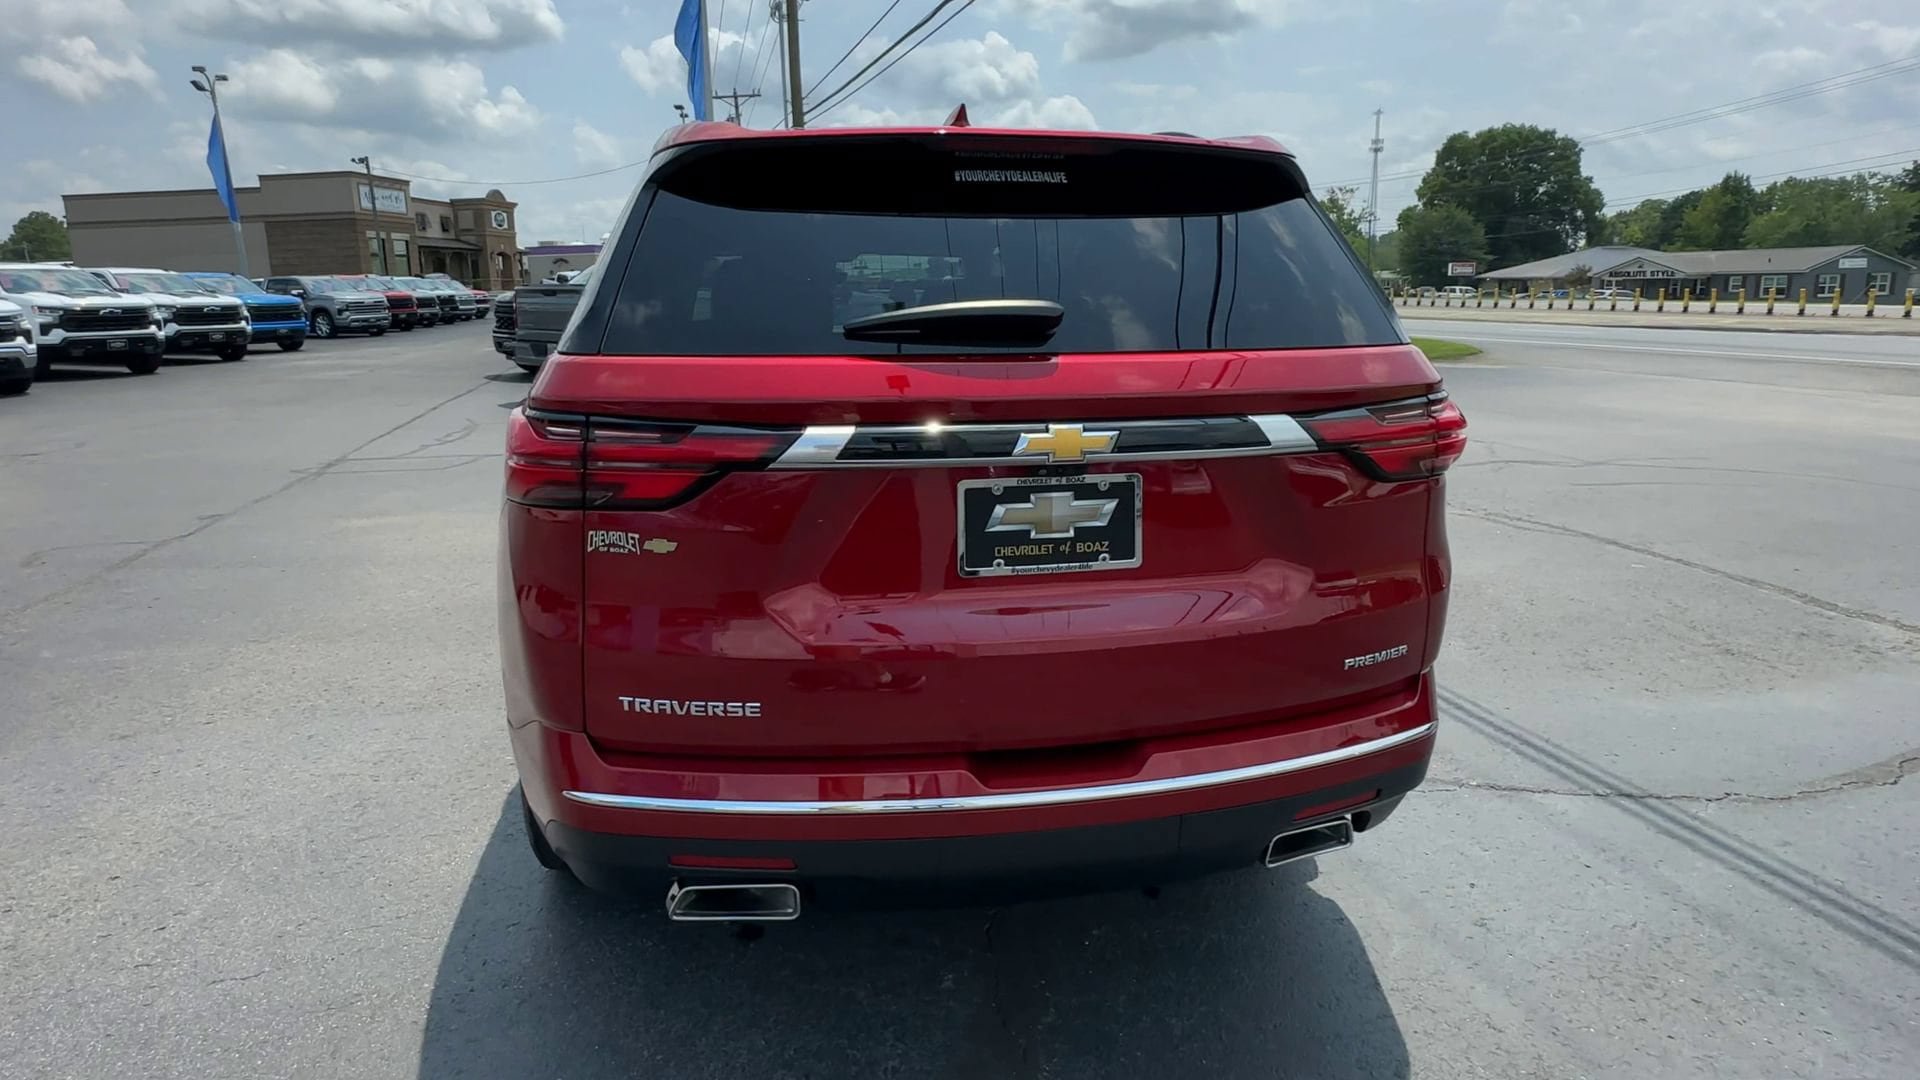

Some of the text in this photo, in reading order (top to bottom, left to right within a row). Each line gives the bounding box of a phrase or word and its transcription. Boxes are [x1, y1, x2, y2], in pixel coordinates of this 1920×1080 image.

[954, 169, 1068, 183] #YOURCHEVYDEALER4LIFE
[1016, 477, 1052, 485] CHEVROLET
[1065, 476, 1086, 484] BOAZ
[587, 530, 640, 556] CHEVROLET
[609, 546, 630, 554] BOAZ
[994, 541, 1109, 557] CHEVROLET of BOAZ
[1344, 644, 1408, 671] PREMIER
[618, 696, 761, 717] TRAVERSE
